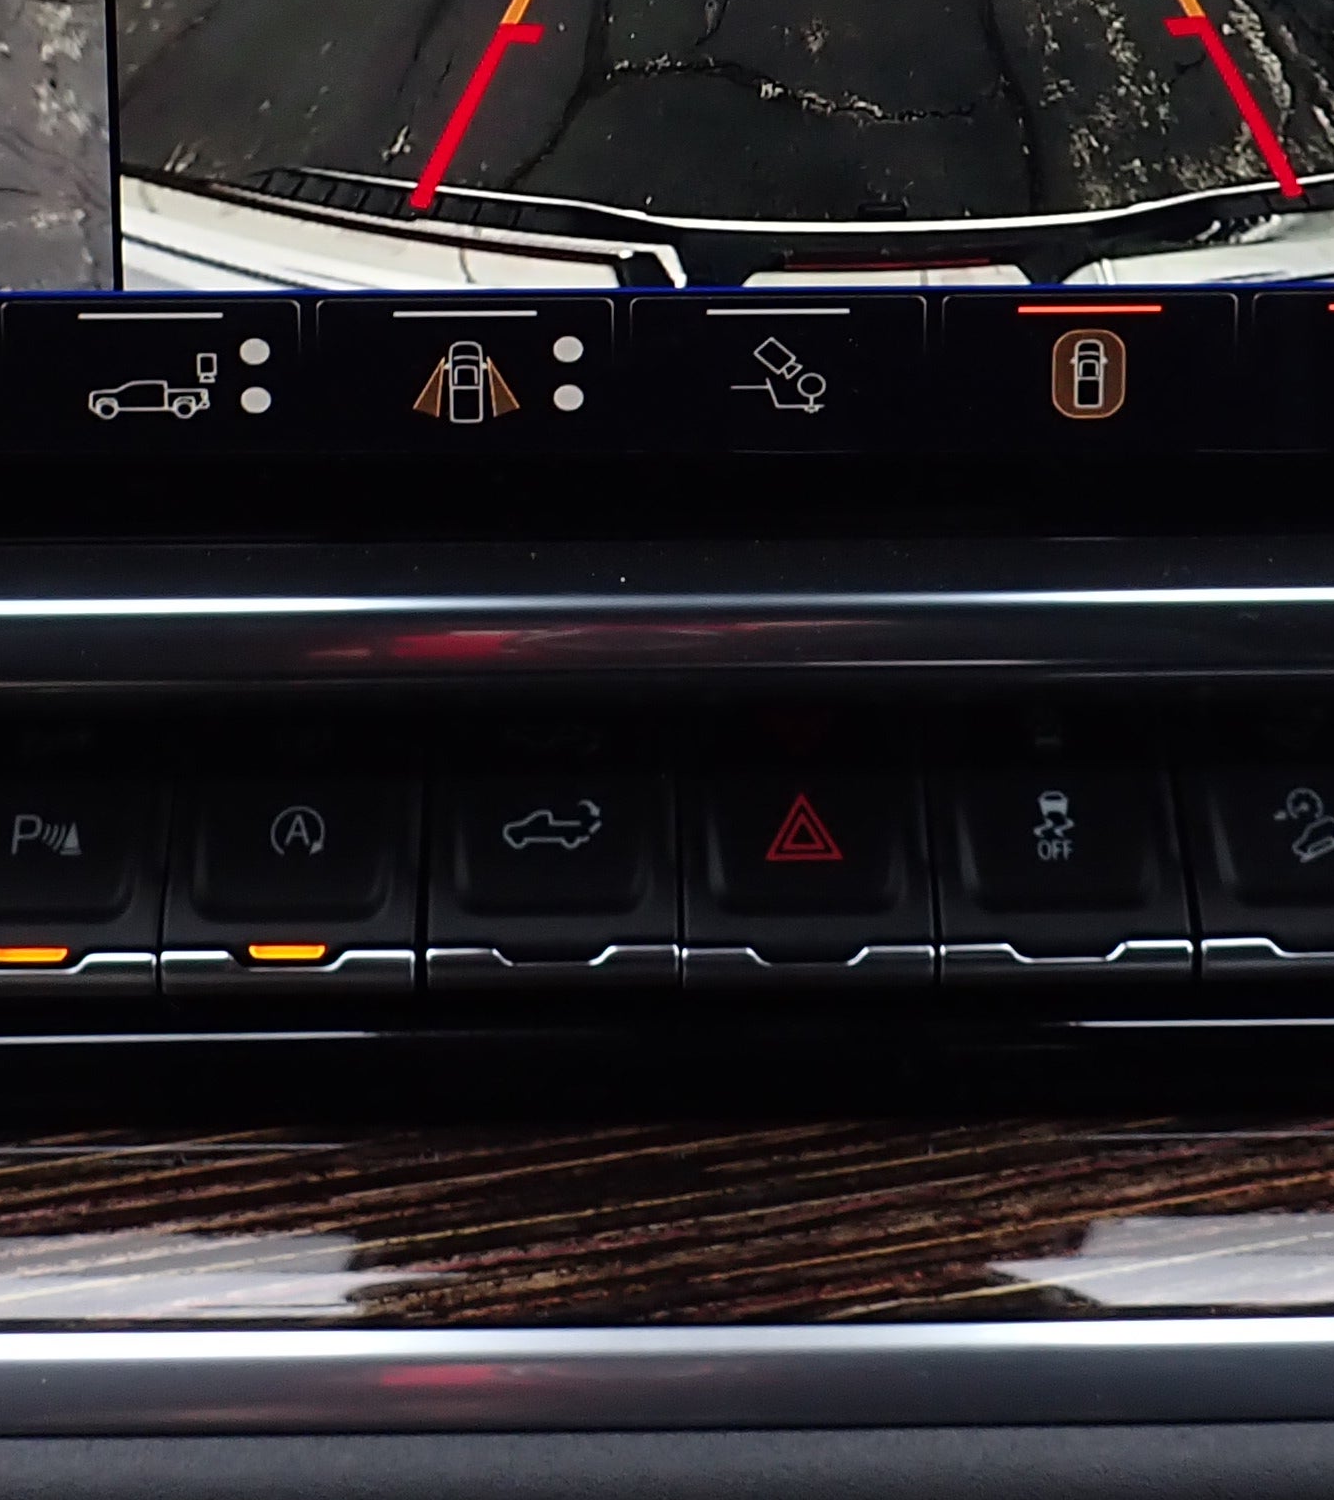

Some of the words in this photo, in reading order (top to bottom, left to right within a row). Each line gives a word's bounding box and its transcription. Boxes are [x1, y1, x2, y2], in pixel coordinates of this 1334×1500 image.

[11, 814, 42, 855] P
[285, 814, 309, 846] A
[1037, 839, 1073, 860] OFF
